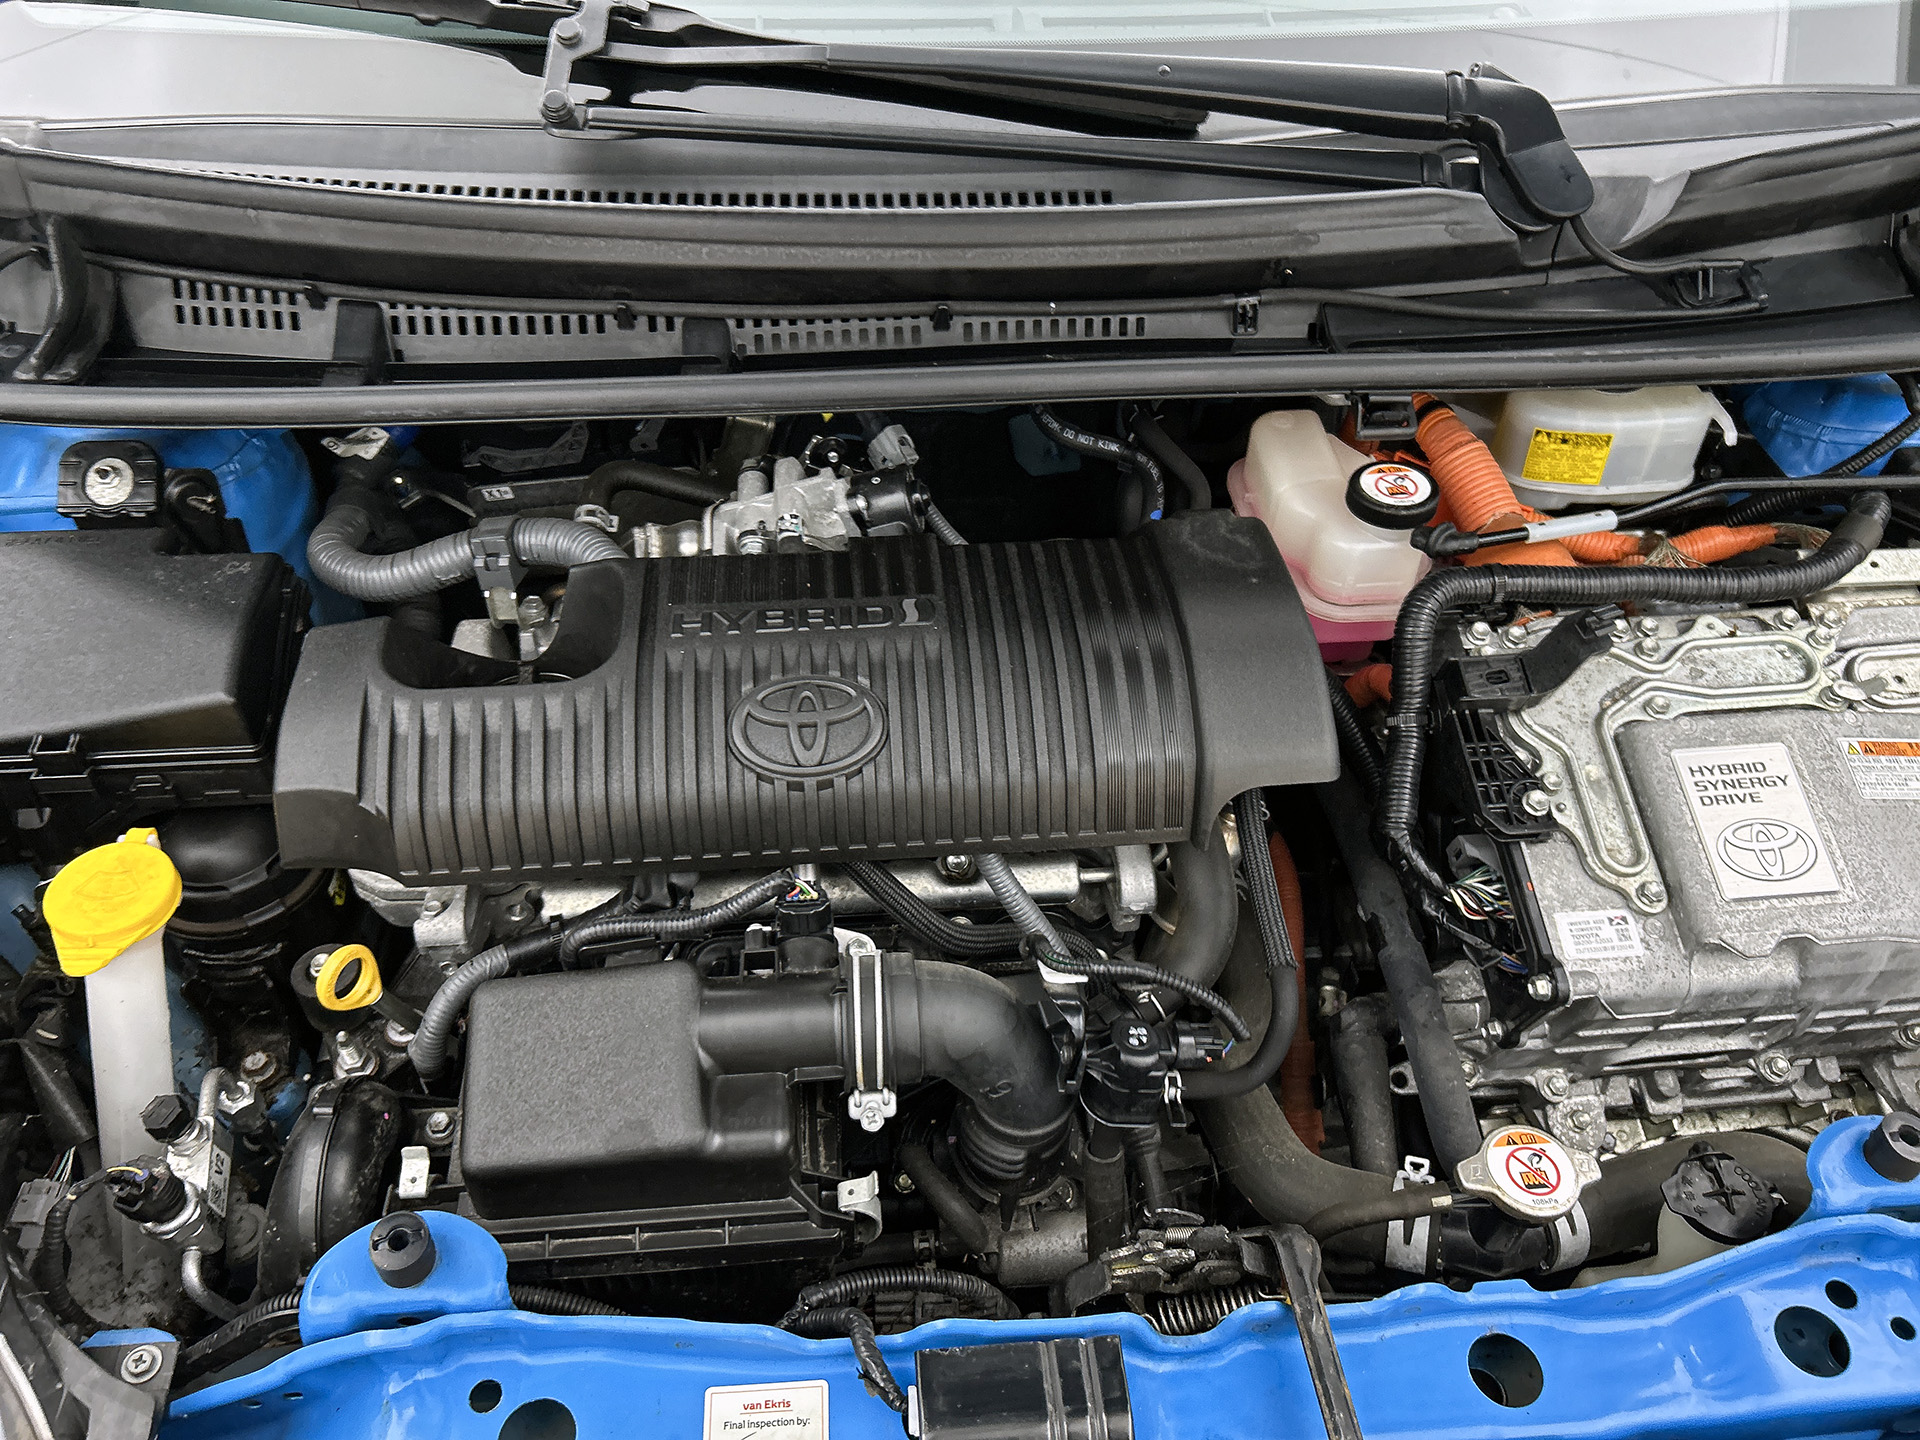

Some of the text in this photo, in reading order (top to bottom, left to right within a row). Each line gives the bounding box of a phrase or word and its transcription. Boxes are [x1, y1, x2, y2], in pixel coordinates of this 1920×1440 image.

[1063, 428, 1076, 439] DO
[1077, 433, 1095, 446] NOT
[1098, 440, 1120, 452] KINK
[671, 604, 895, 637] HYBRID
[1688, 762, 1767, 777] HYBRID
[1694, 775, 1789, 792] SYNERGY
[1699, 792, 1763, 806] DRIVE
[1571, 932, 1600, 940] TOYOTA
[1532, 1198, 1559, 1206] 108kPa
[743, 1399, 791, 1411] van Ekris
[723, 1416, 811, 1430] Final inspection by:
